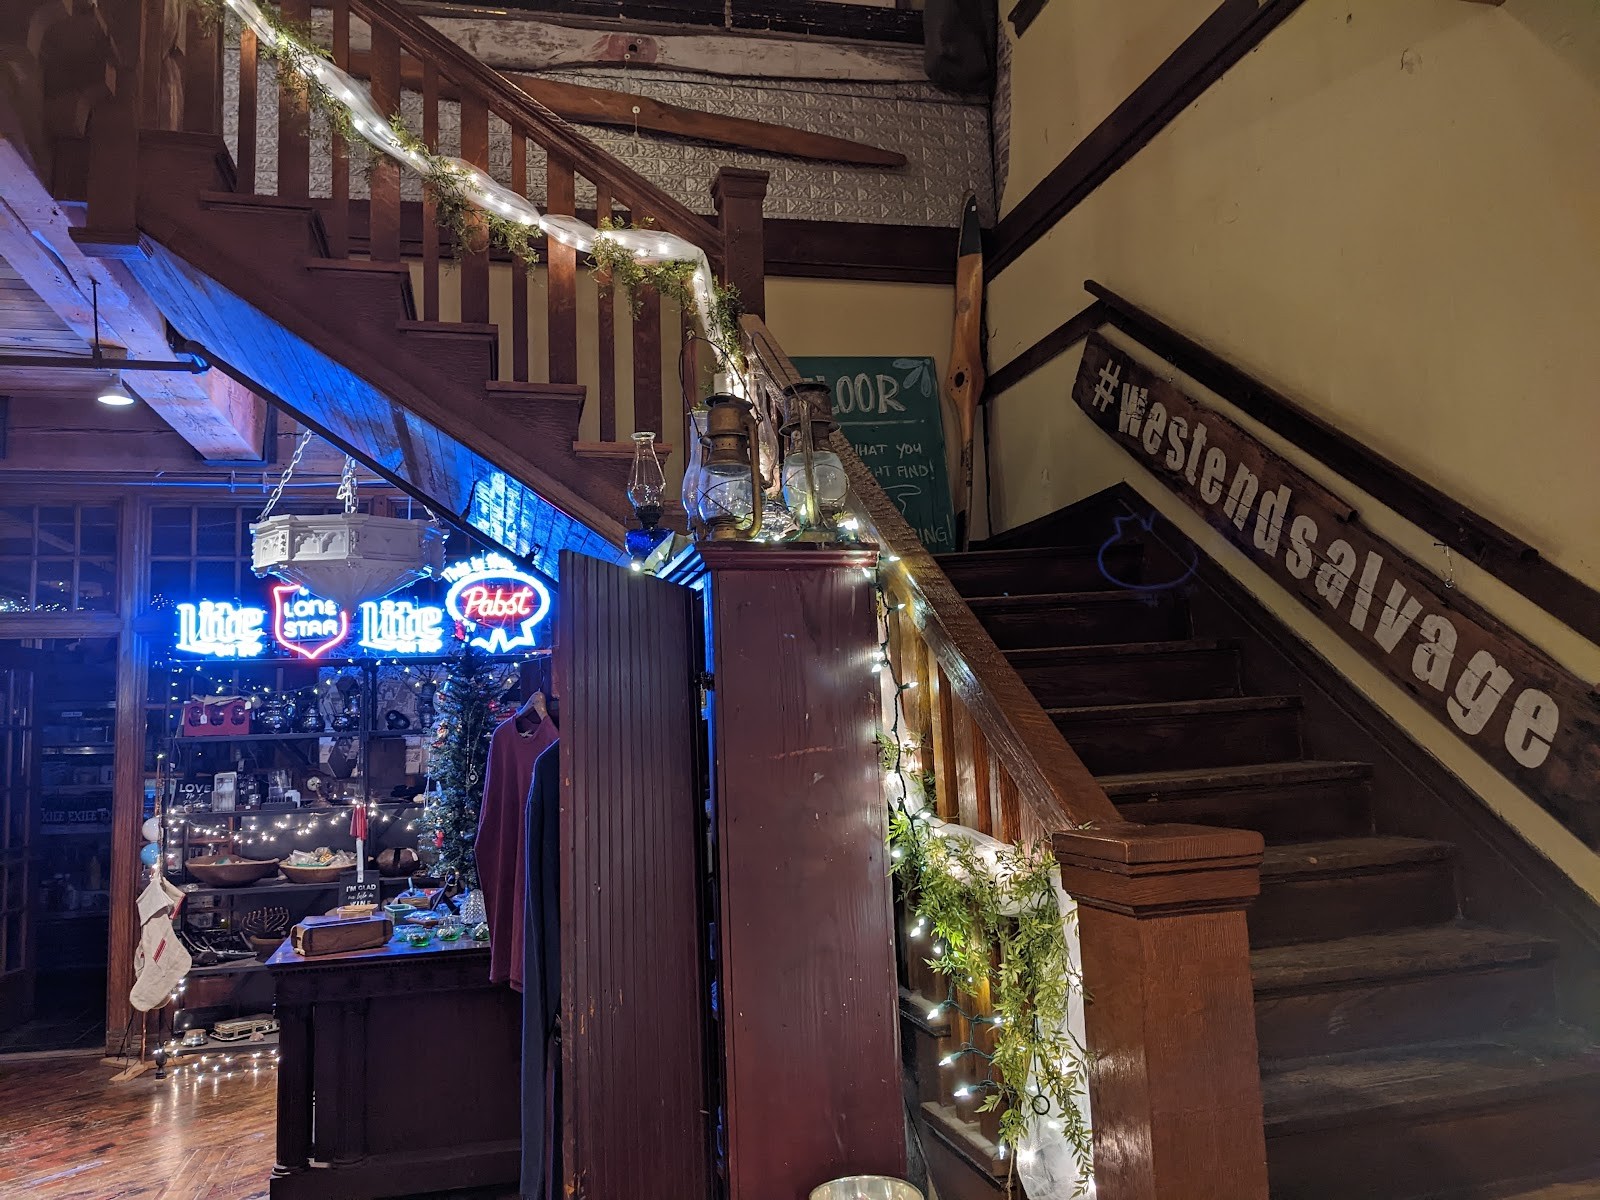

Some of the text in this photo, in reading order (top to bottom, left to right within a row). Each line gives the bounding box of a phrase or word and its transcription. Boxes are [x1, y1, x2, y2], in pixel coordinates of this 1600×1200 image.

[802, 373, 906, 414] OOR
[896, 443, 922, 459] YOU
[897, 459, 936, 480] FIND!
[1093, 359, 1559, 768] #westendsalvage
[284, 599, 337, 618] LONE
[461, 587, 533, 618] Pabst
[284, 619, 338, 638] STAR
[179, 784, 212, 793] LOVE
